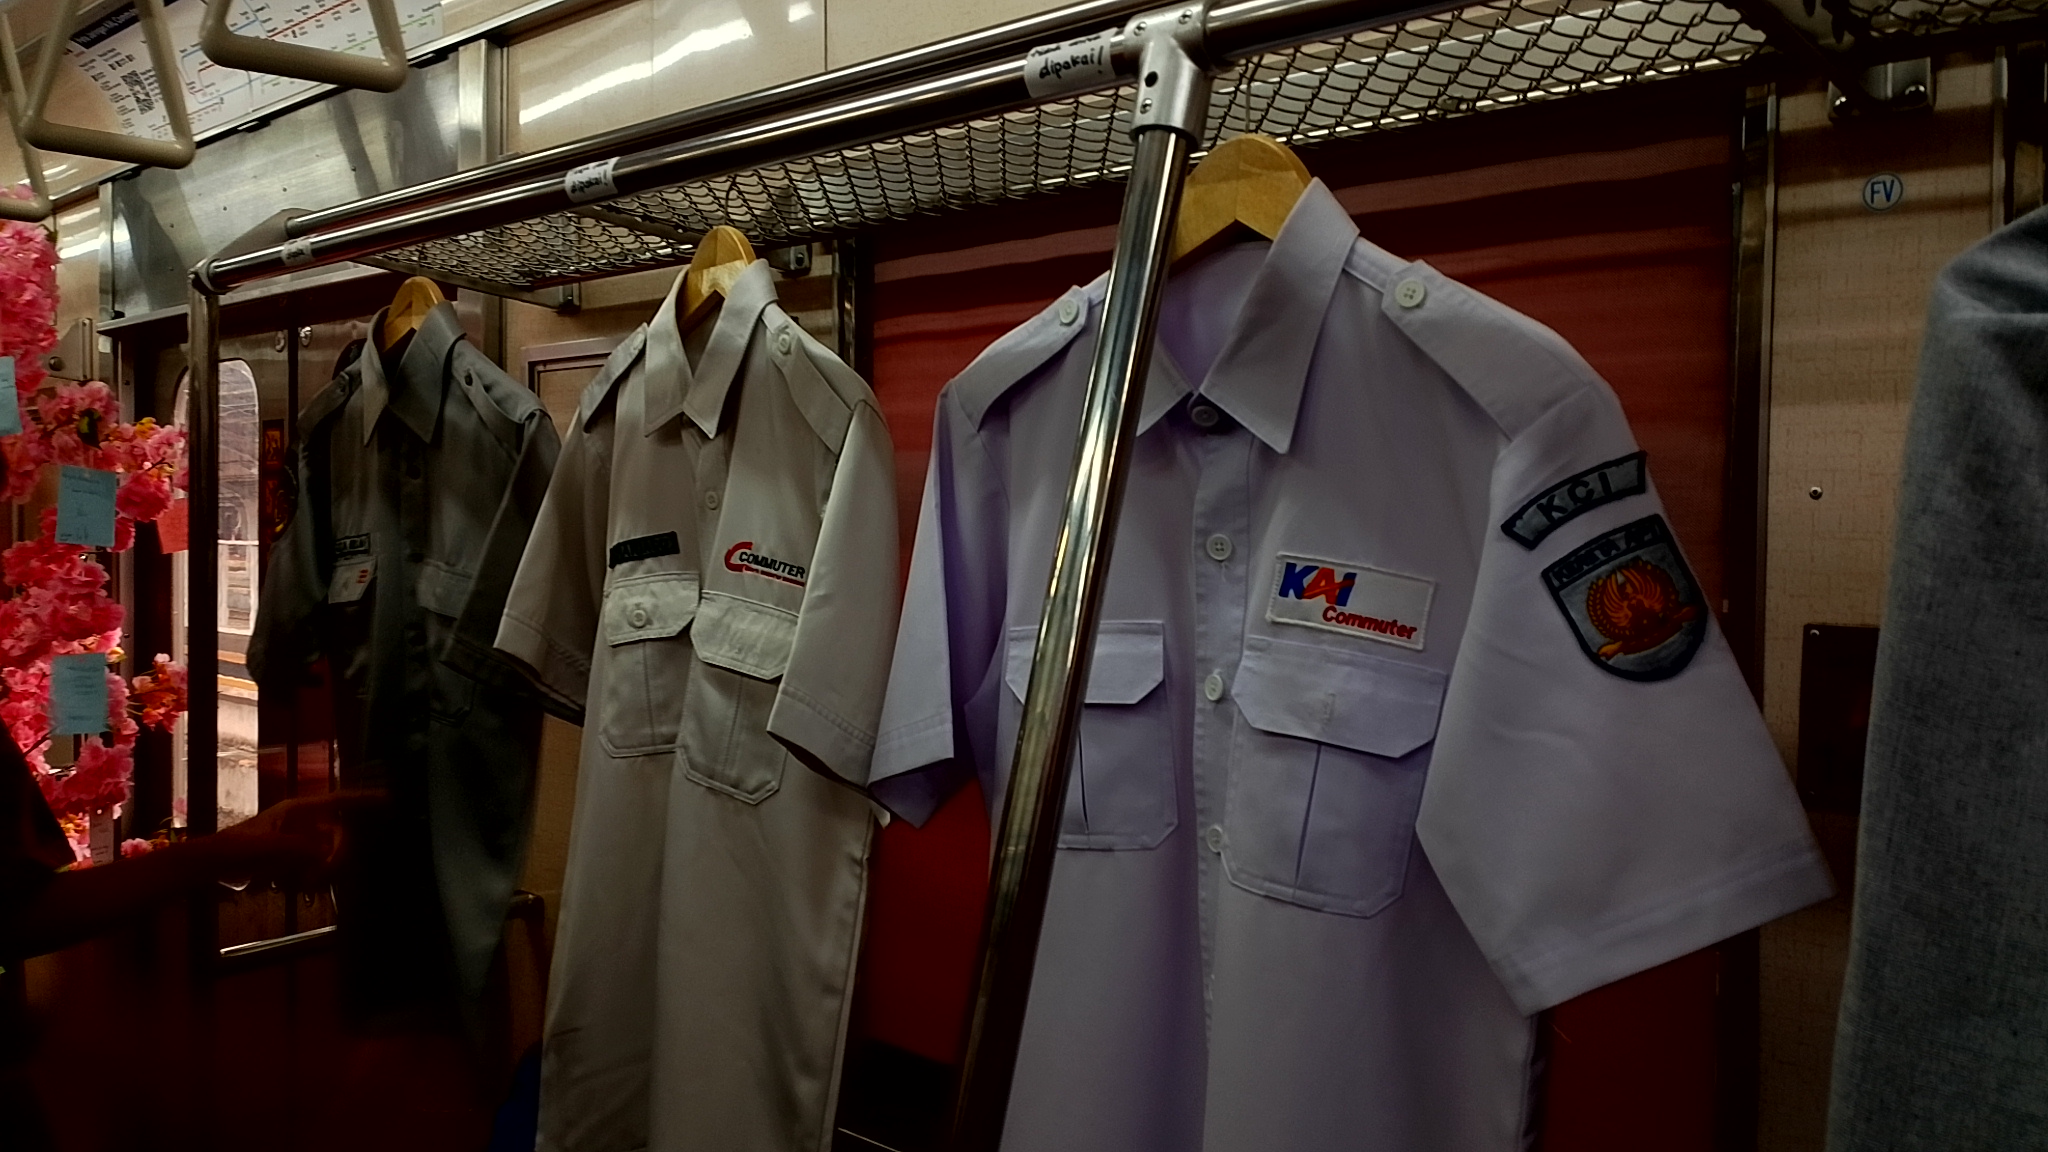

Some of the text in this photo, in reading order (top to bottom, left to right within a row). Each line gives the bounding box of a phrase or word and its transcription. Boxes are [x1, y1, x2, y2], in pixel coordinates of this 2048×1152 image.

[1039, 45, 1104, 79] dipakai!
[1870, 179, 1895, 204] FV
[1536, 471, 1613, 523] KCI
[739, 551, 806, 579] COMMUTER
[1279, 563, 1358, 606] KAI
[1322, 607, 1418, 639] Commuter
